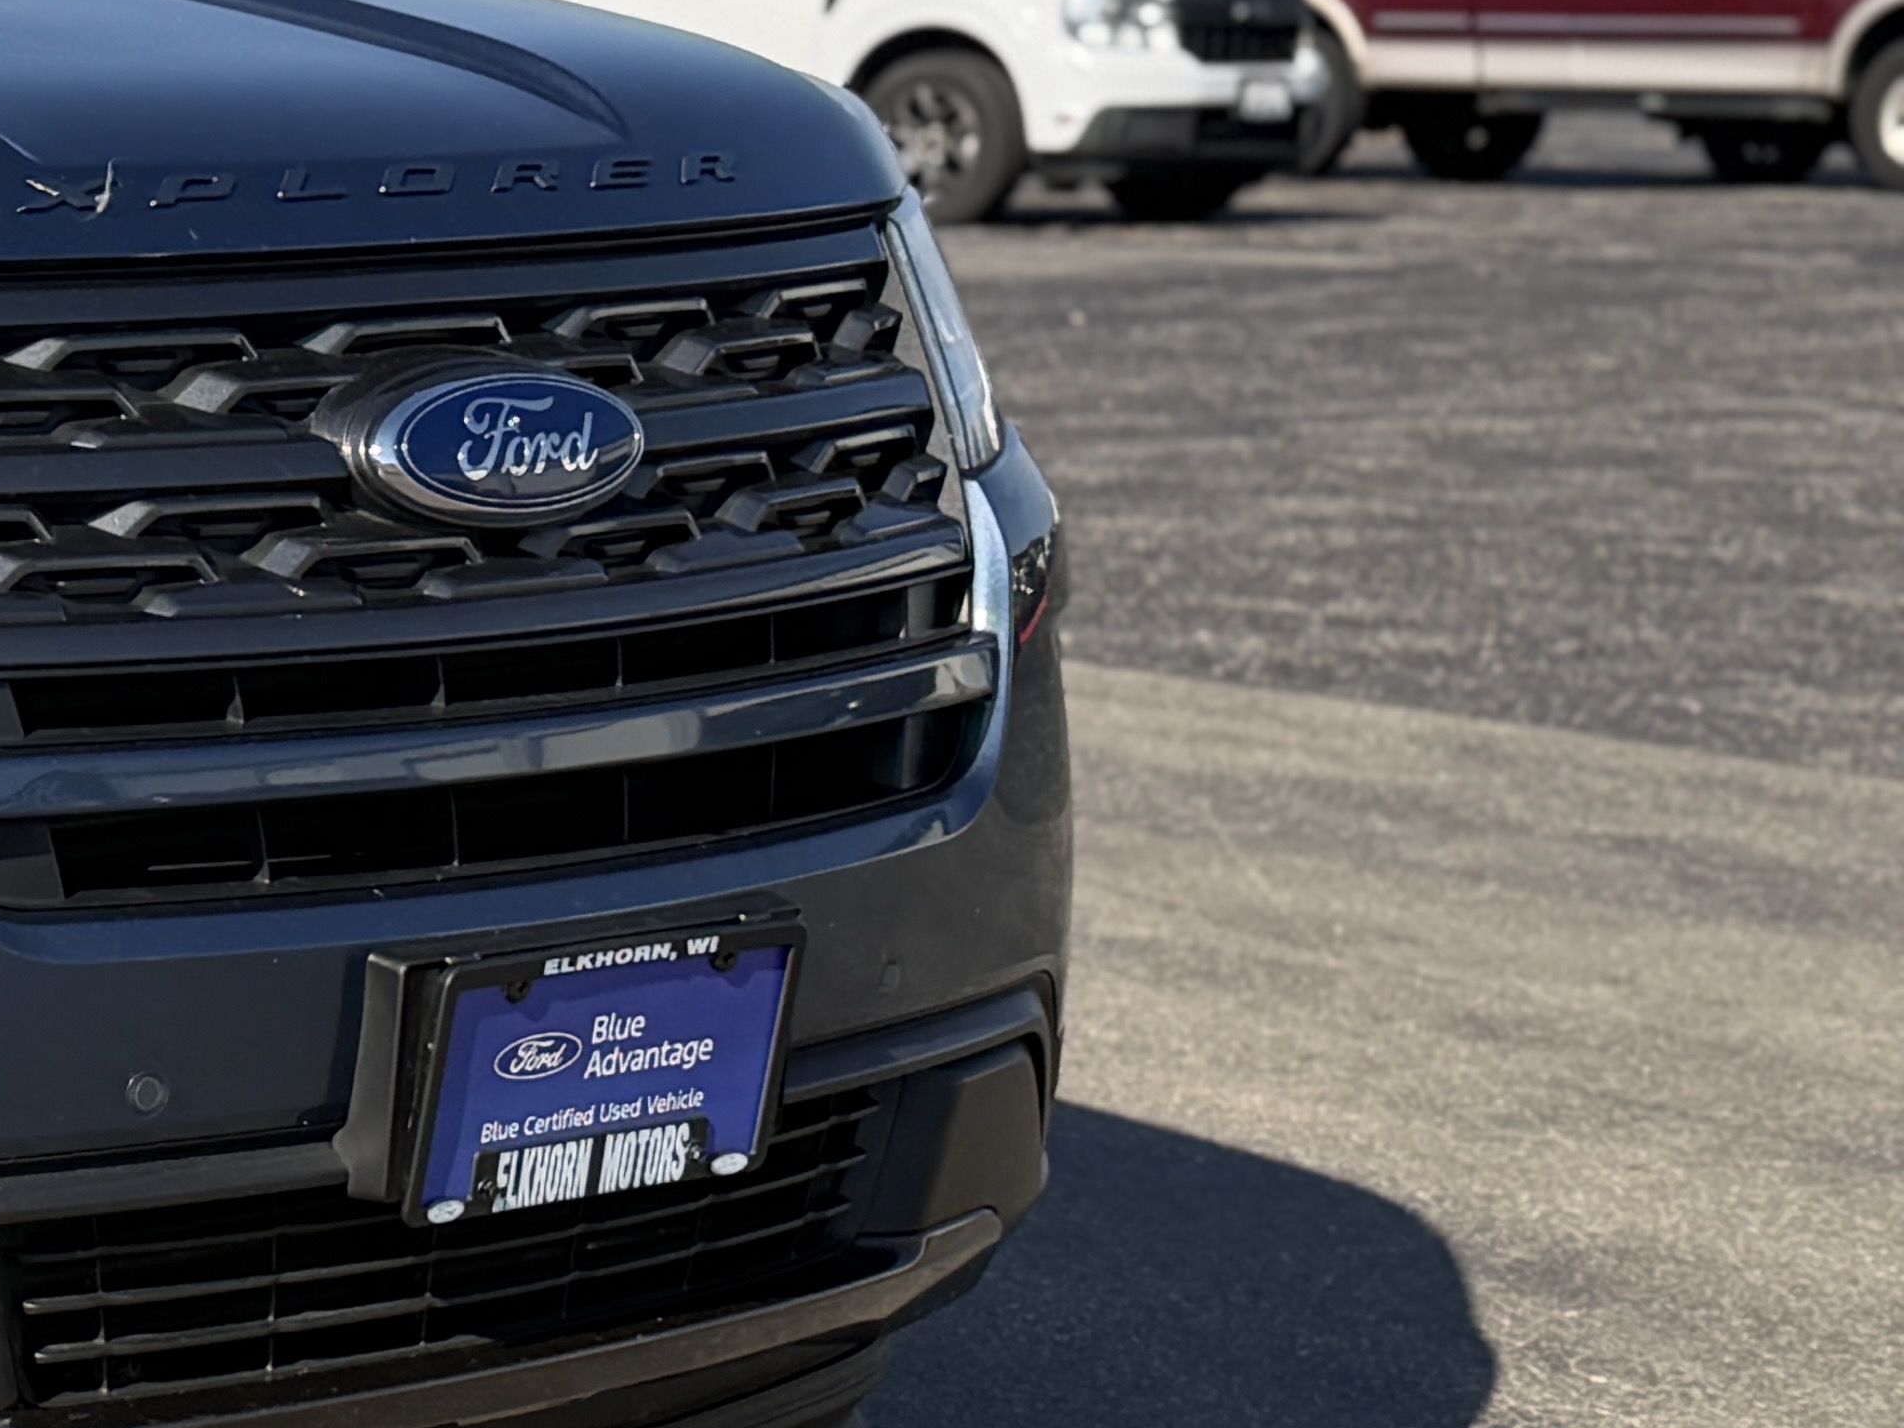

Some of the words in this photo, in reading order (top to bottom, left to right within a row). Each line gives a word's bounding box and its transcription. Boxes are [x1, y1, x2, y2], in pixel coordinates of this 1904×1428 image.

[457, 396, 598, 481] Ford
[543, 943, 677, 975] ELKHORN,
[686, 936, 719, 954] WI
[592, 1013, 646, 1044] Blue
[509, 1038, 566, 1074] Ford
[584, 1035, 714, 1080] Advantage
[481, 1121, 520, 1144] Blue
[523, 1109, 594, 1136] Certified
[599, 1101, 642, 1123] Used
[646, 1088, 704, 1115] Vehicle
[492, 1138, 593, 1213] ELKHORN
[598, 1123, 690, 1194] MOTORS
